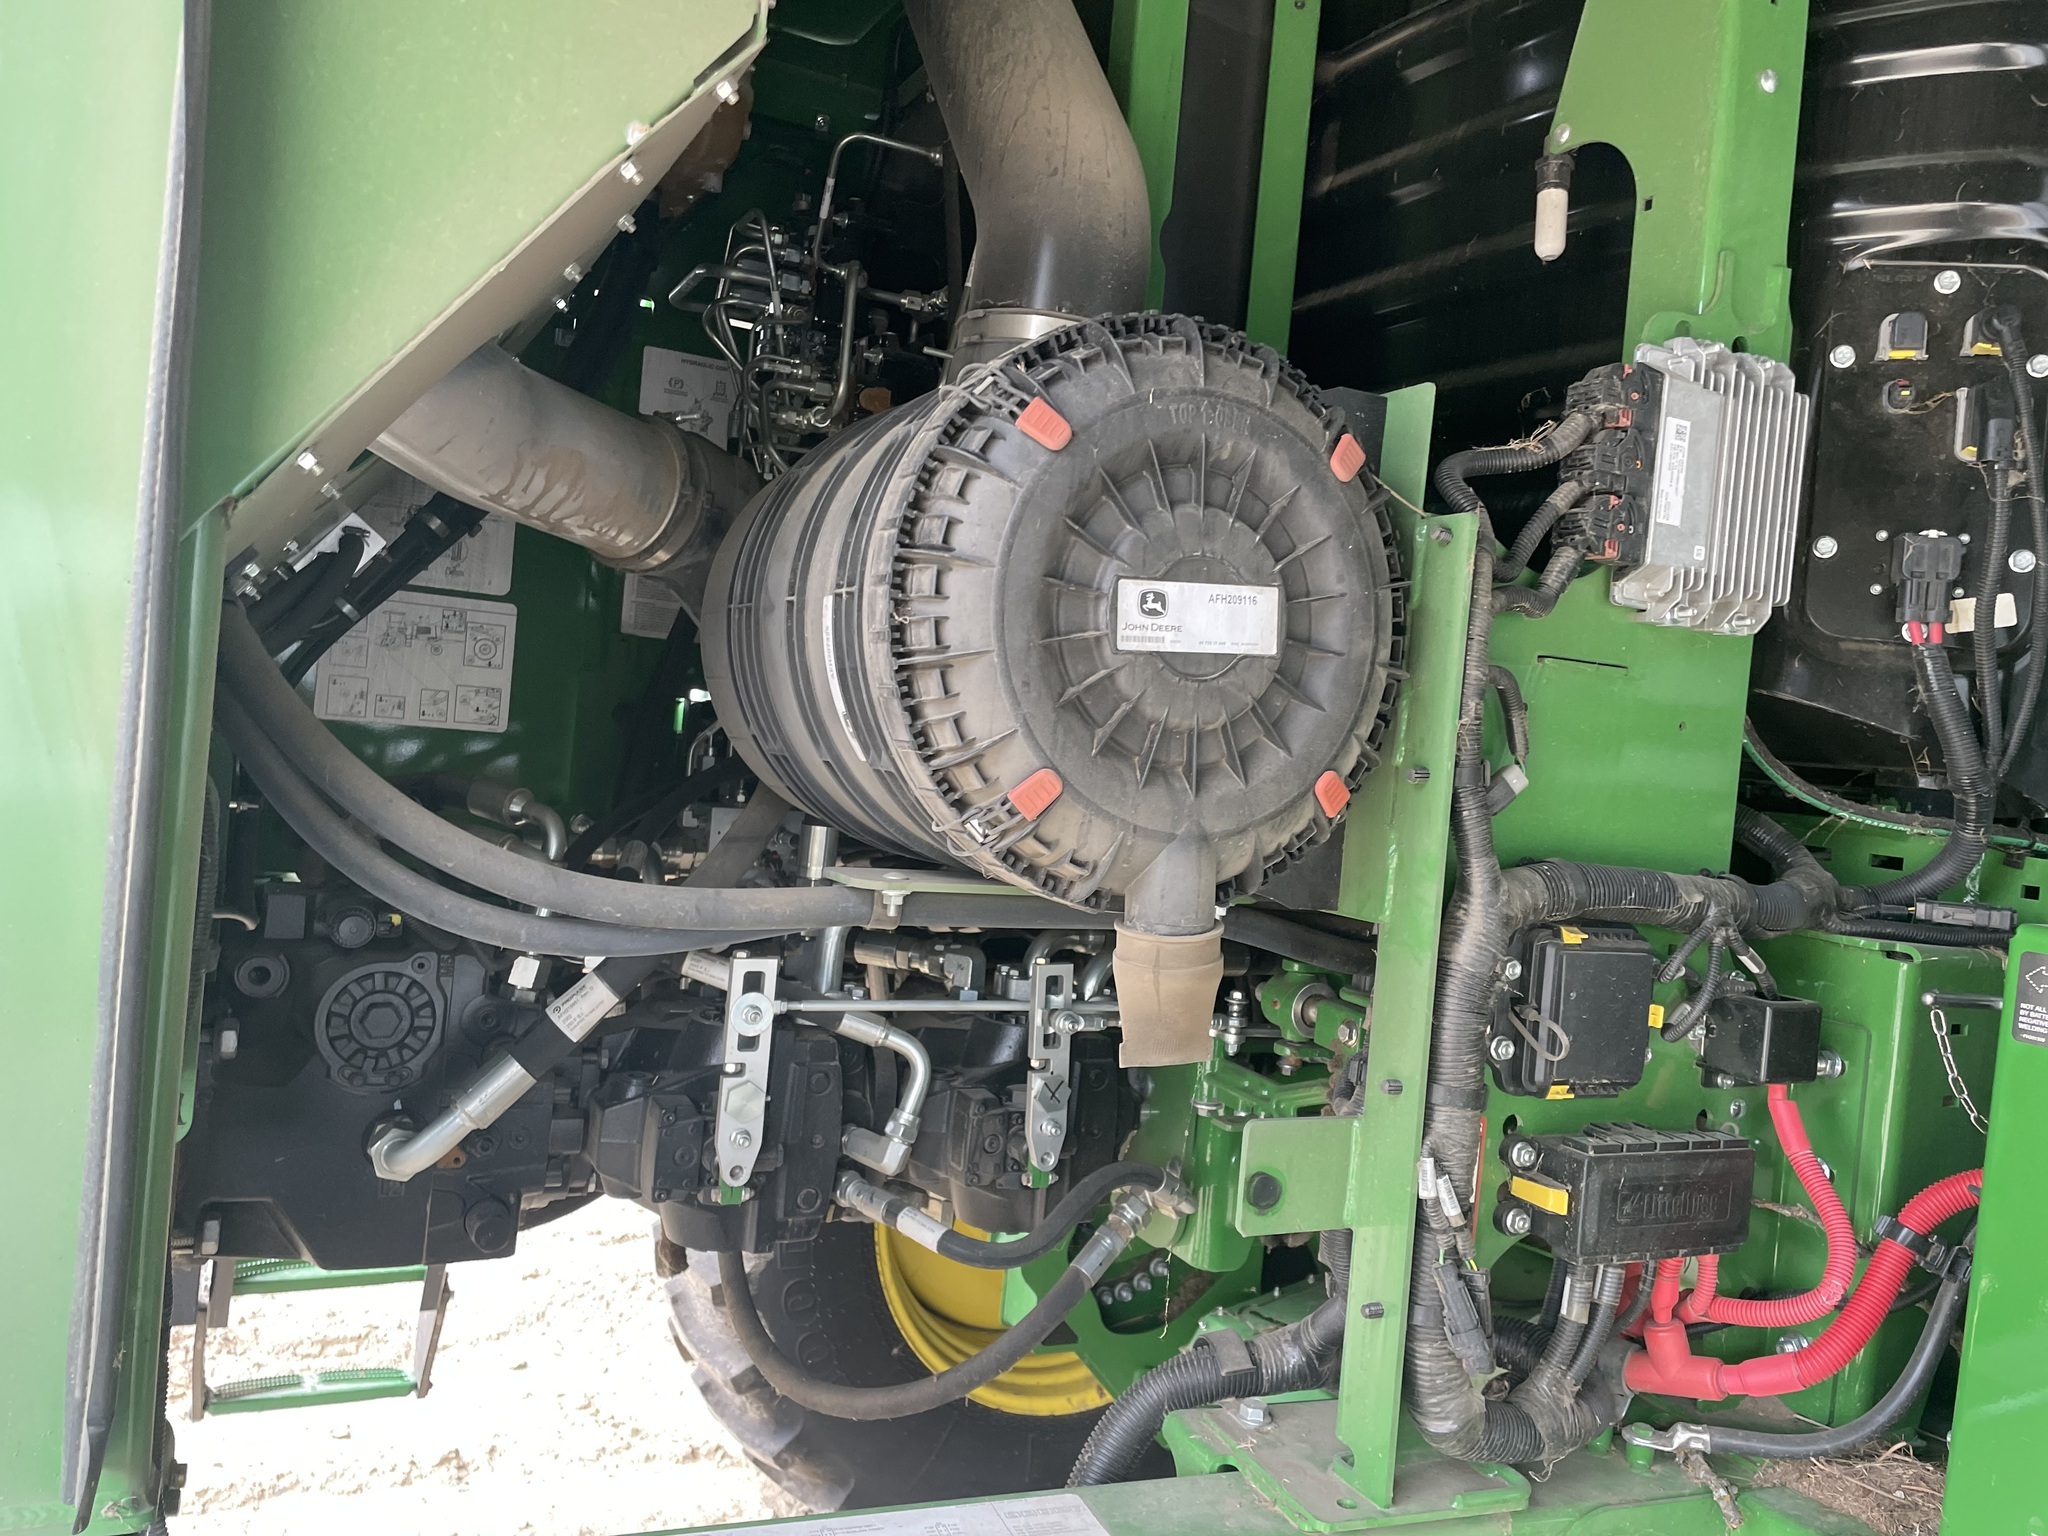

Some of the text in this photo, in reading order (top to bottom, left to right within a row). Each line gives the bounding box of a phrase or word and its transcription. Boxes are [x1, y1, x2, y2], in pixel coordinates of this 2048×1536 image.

[1208, 593, 1258, 606] AFH209116
[1121, 622, 1183, 633] JOHN DEERE
[2020, 1002, 2035, 1011] NOT
[2018, 1022, 2048, 1034] WELDING
